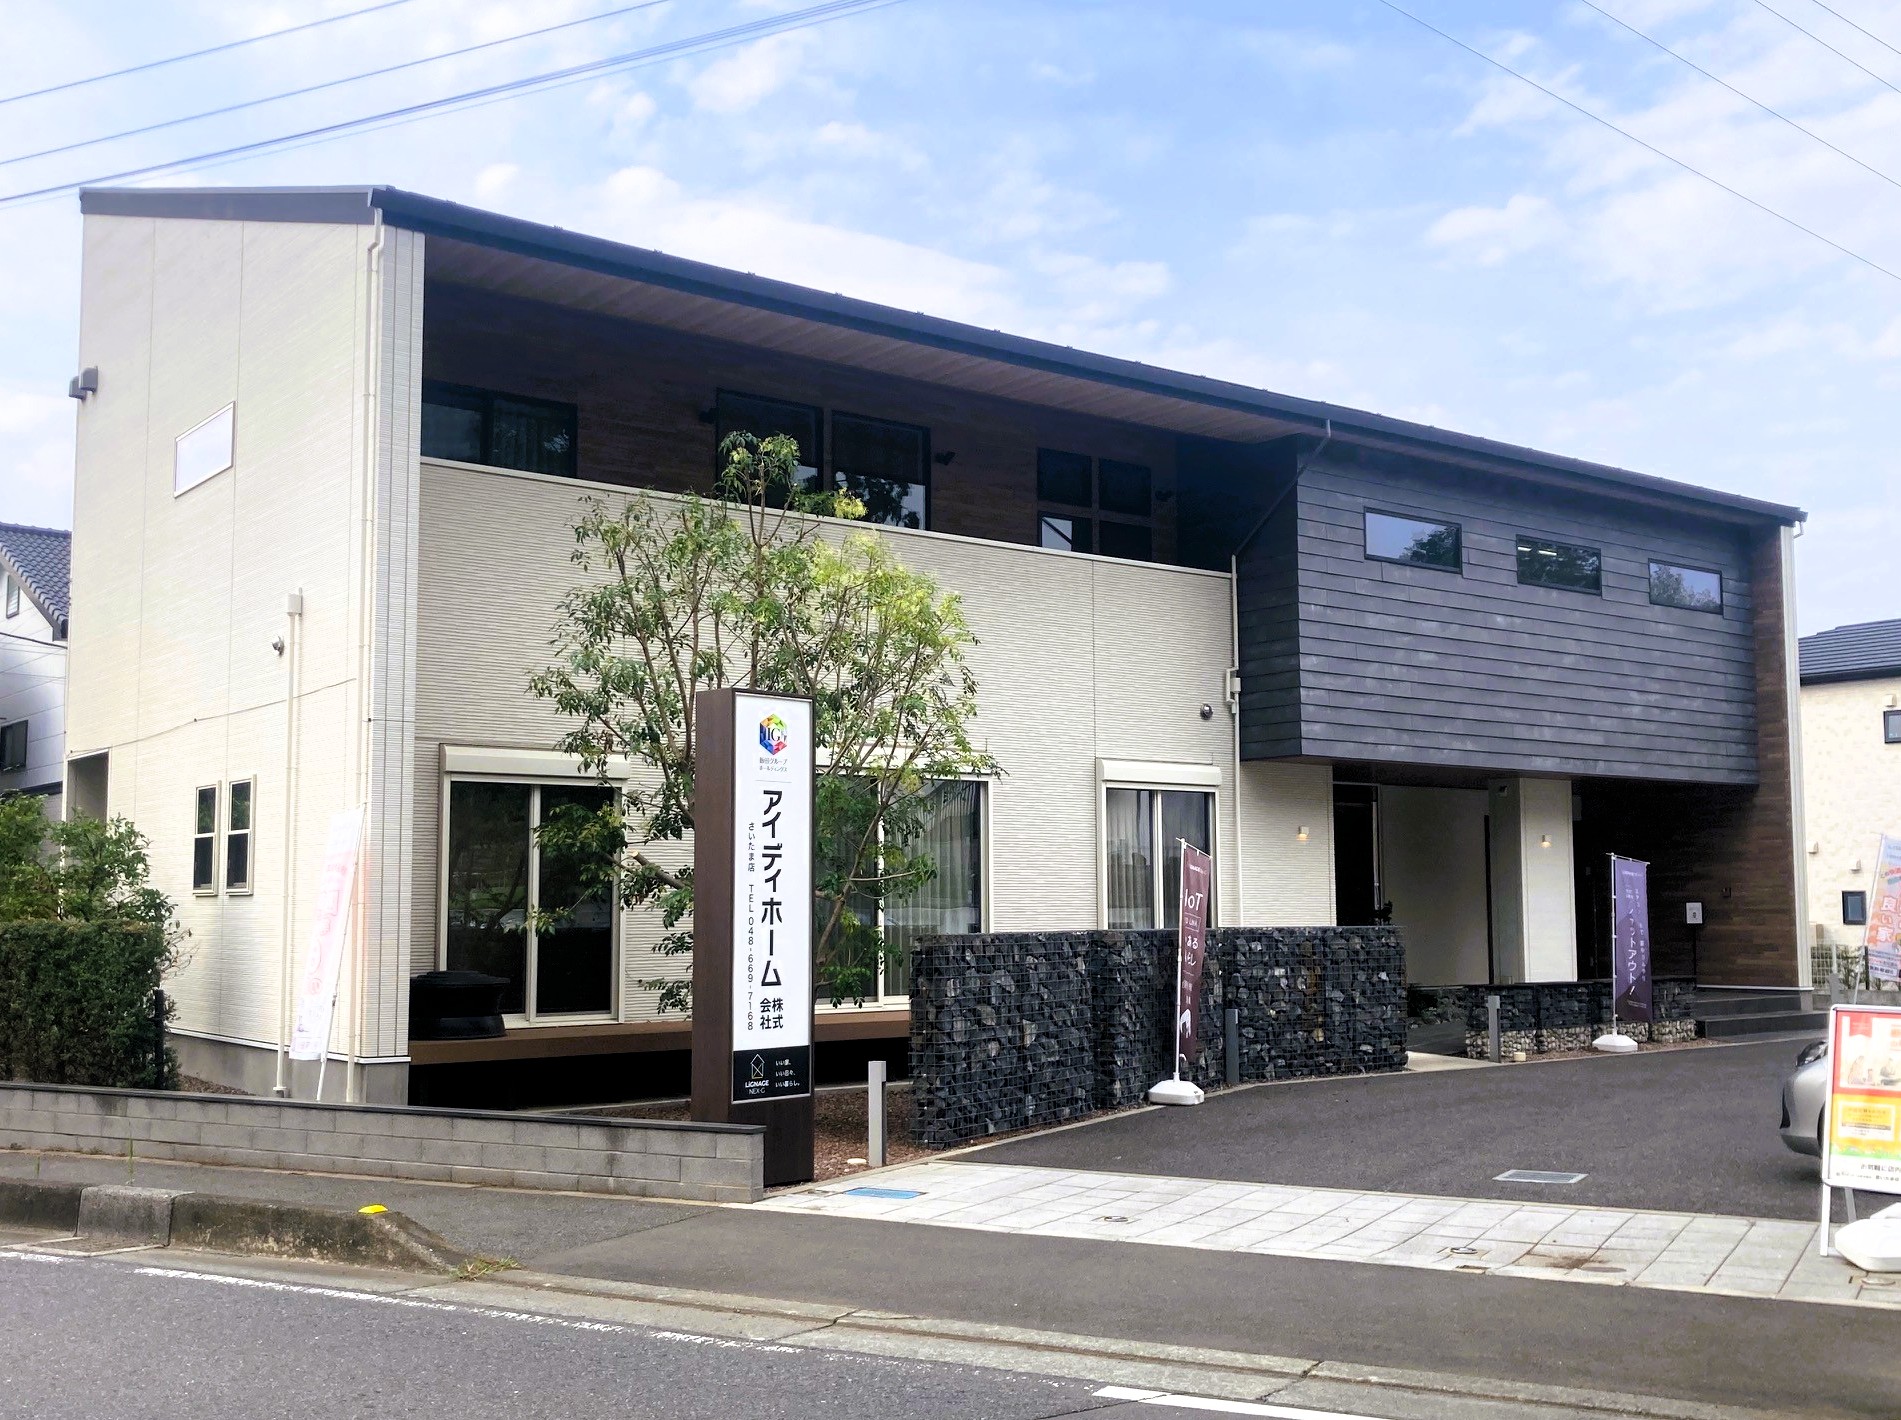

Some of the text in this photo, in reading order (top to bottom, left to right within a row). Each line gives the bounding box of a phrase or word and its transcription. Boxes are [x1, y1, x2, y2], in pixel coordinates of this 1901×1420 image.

[747, 822, 756, 872] さいたま店
[761, 790, 783, 987] アイディホーム
[1184, 888, 1204, 911] IoT
[747, 916, 755, 1031] 048-669-7168
